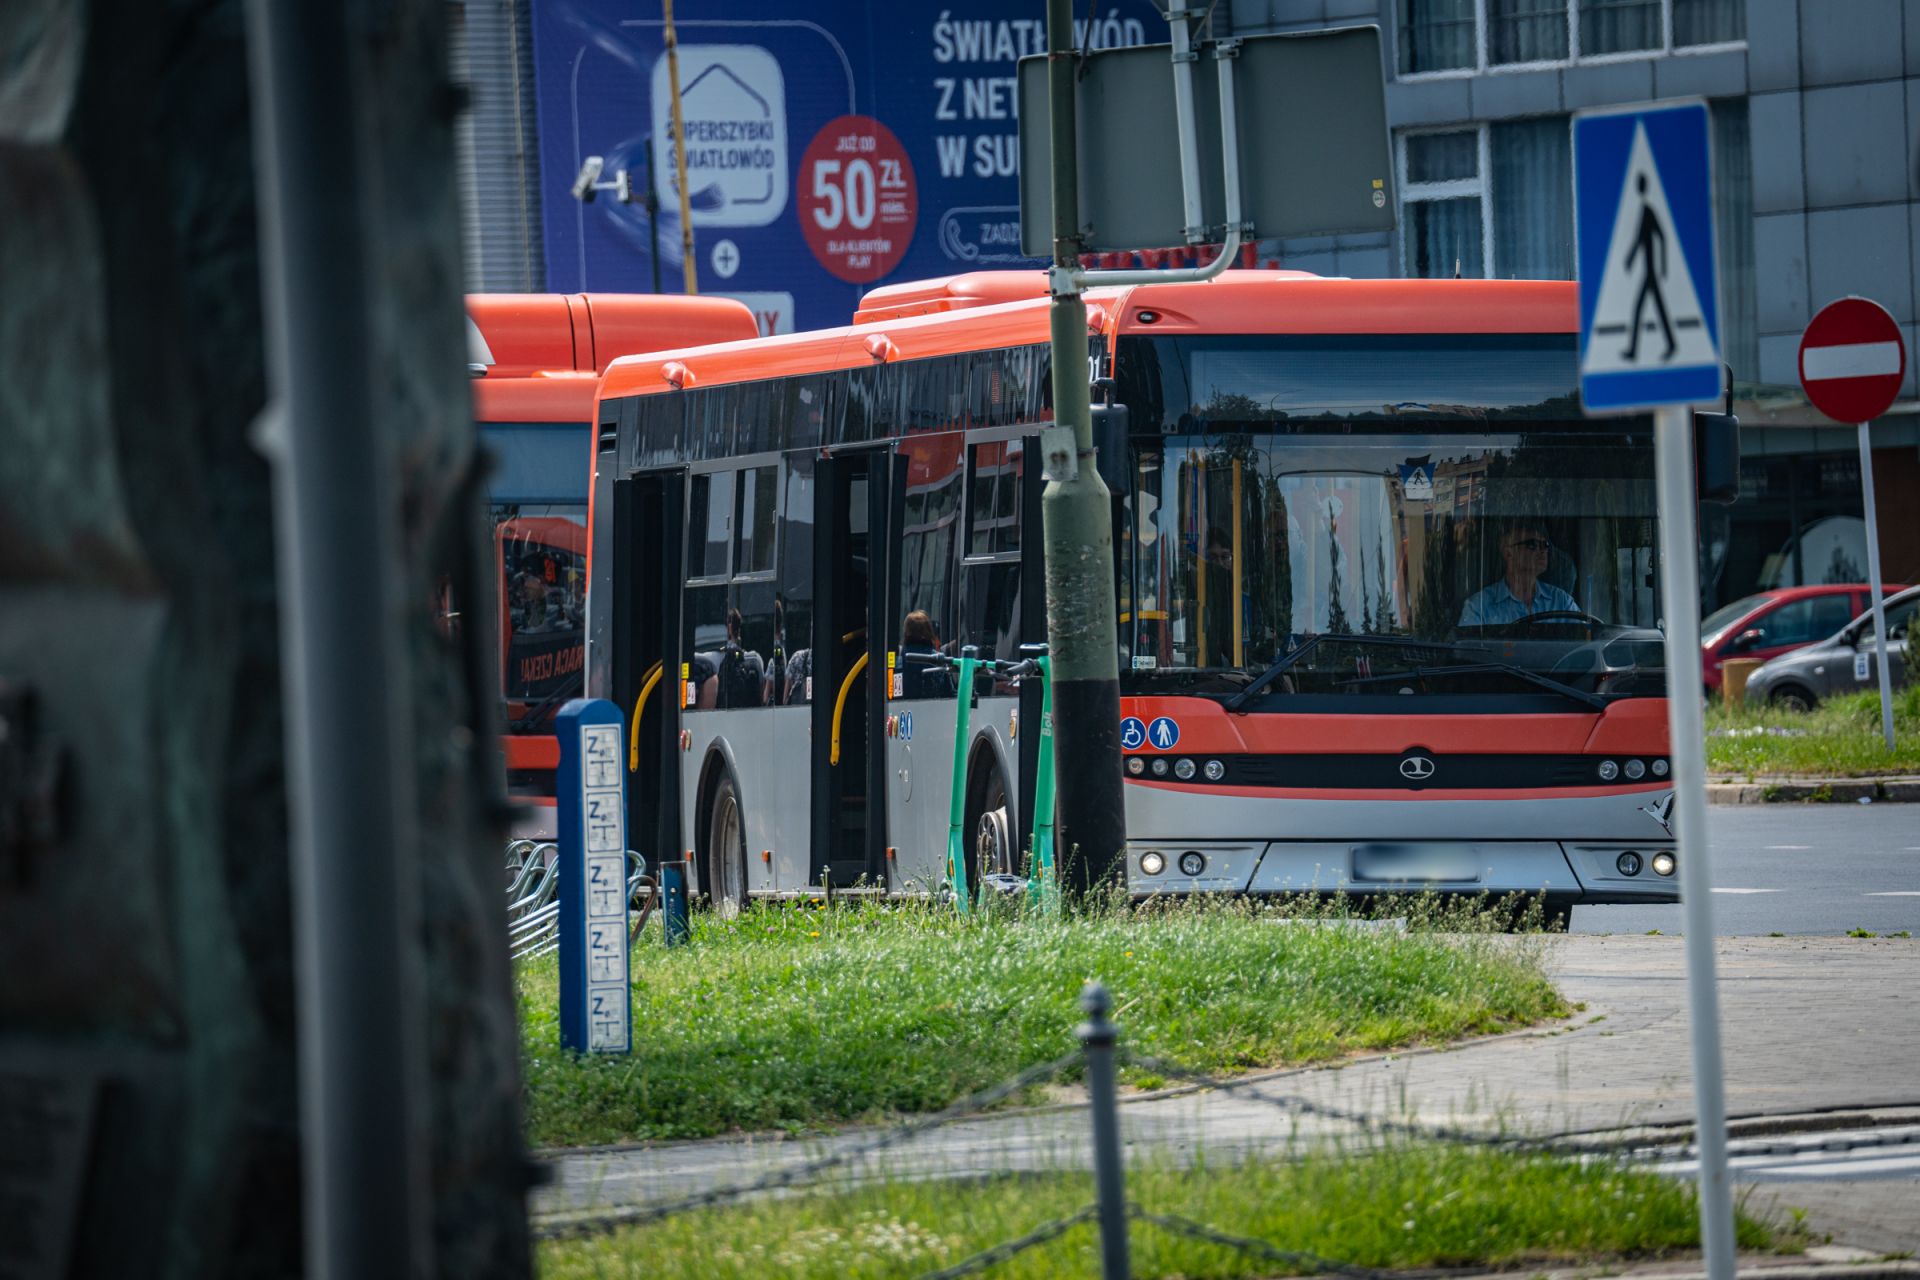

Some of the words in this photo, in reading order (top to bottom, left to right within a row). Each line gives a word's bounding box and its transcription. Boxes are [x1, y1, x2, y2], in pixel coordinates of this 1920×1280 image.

[933, 9, 1145, 62] ŚWIATŁWÓD
[934, 78, 957, 120] Z
[836, 133, 857, 152] JUŻ
[860, 136, 876, 152] OD
[936, 135, 967, 178] W
[973, 135, 1020, 178] SU
[813, 158, 876, 230] 50
[879, 159, 908, 188] ZŁ
[847, 254, 872, 268] PLAY
